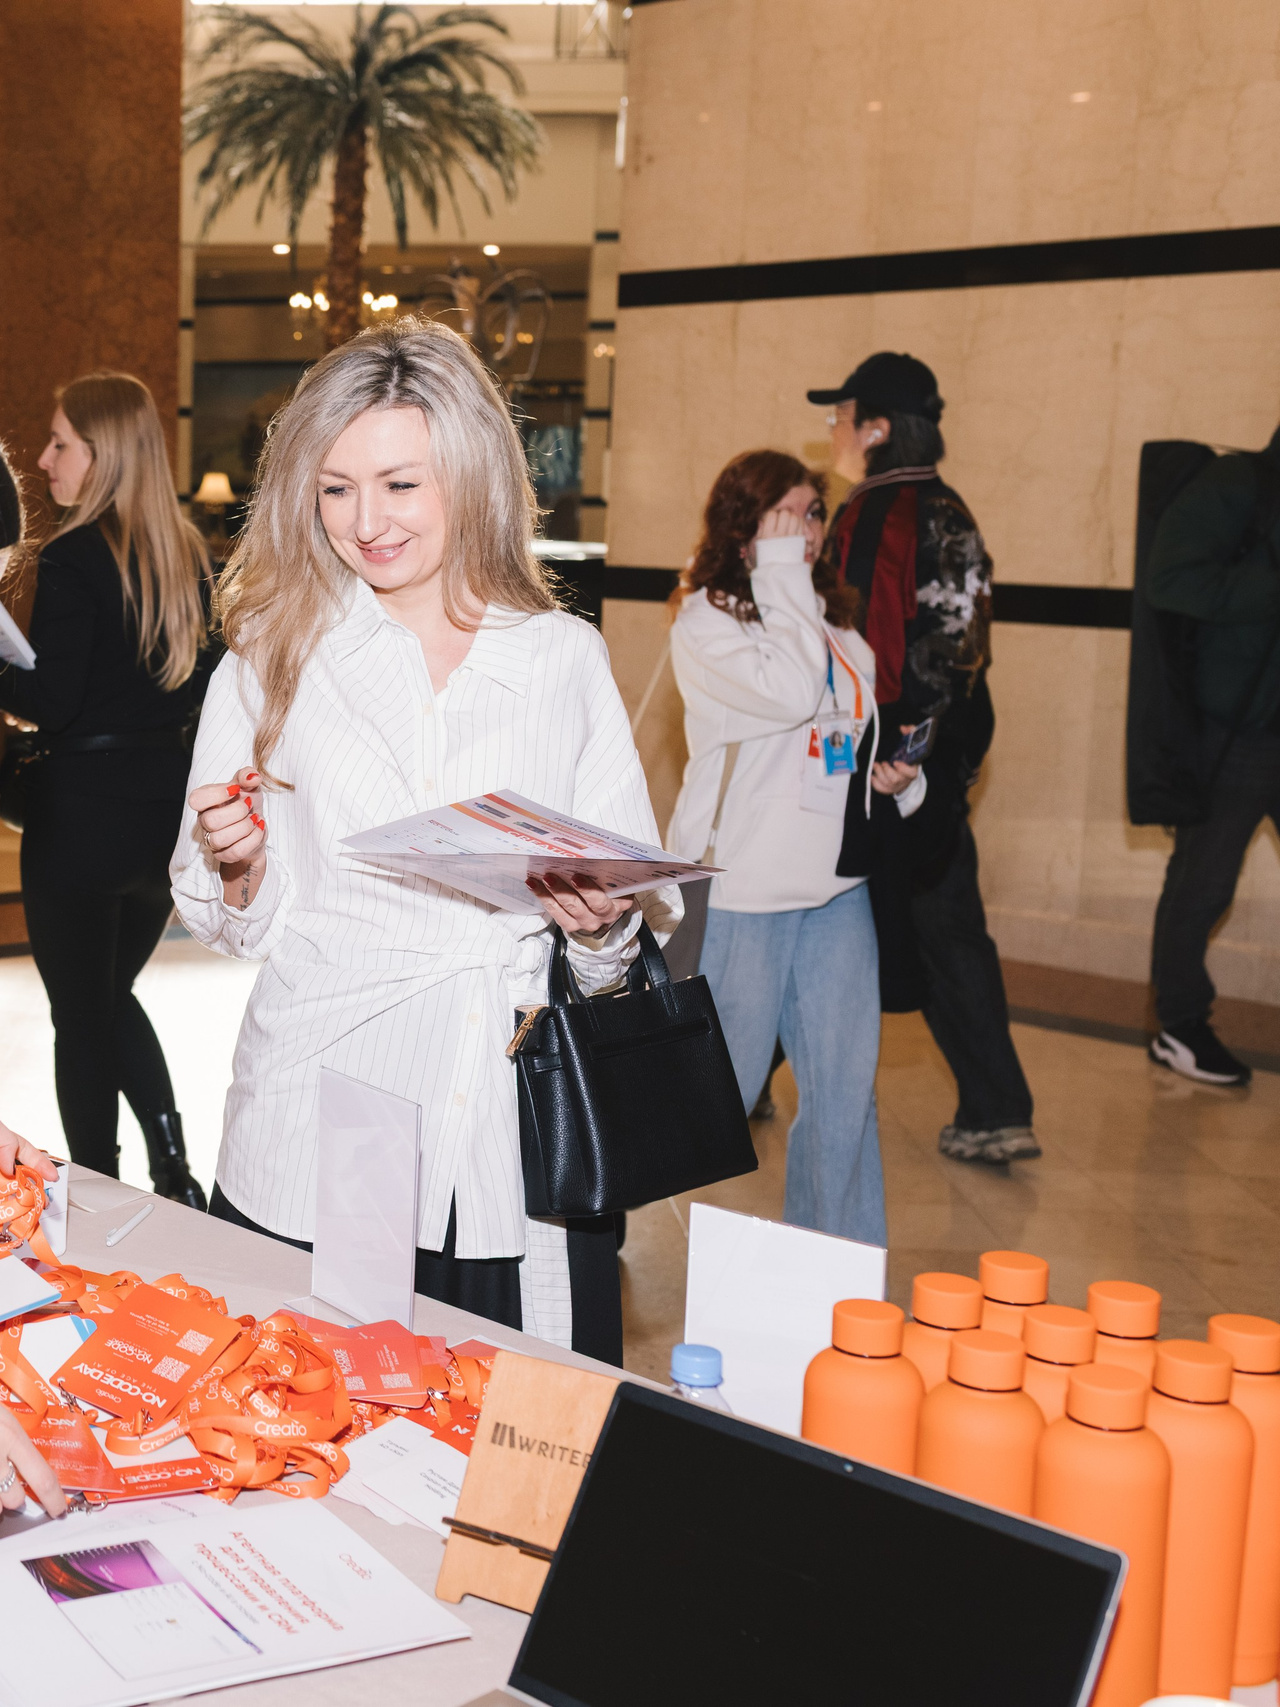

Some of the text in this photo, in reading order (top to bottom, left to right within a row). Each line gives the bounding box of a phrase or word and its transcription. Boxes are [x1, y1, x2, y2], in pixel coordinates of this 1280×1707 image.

[612, 839, 648, 854] CREATIO
[104, 1339, 153, 1364] NO-CODE
[72, 1363, 167, 1408] NO-CODE DAY
[94, 1388, 122, 1404] Creatio
[140, 1426, 190, 1452] Creatio
[254, 1420, 307, 1437] Creatio
[195, 1543, 260, 1602] процессами
[268, 1612, 299, 1634] CRM
[220, 1546, 245, 1564] для
[237, 1565, 310, 1624] управления
[232, 1532, 281, 1576] Агентная
[281, 1577, 344, 1631] платформа
